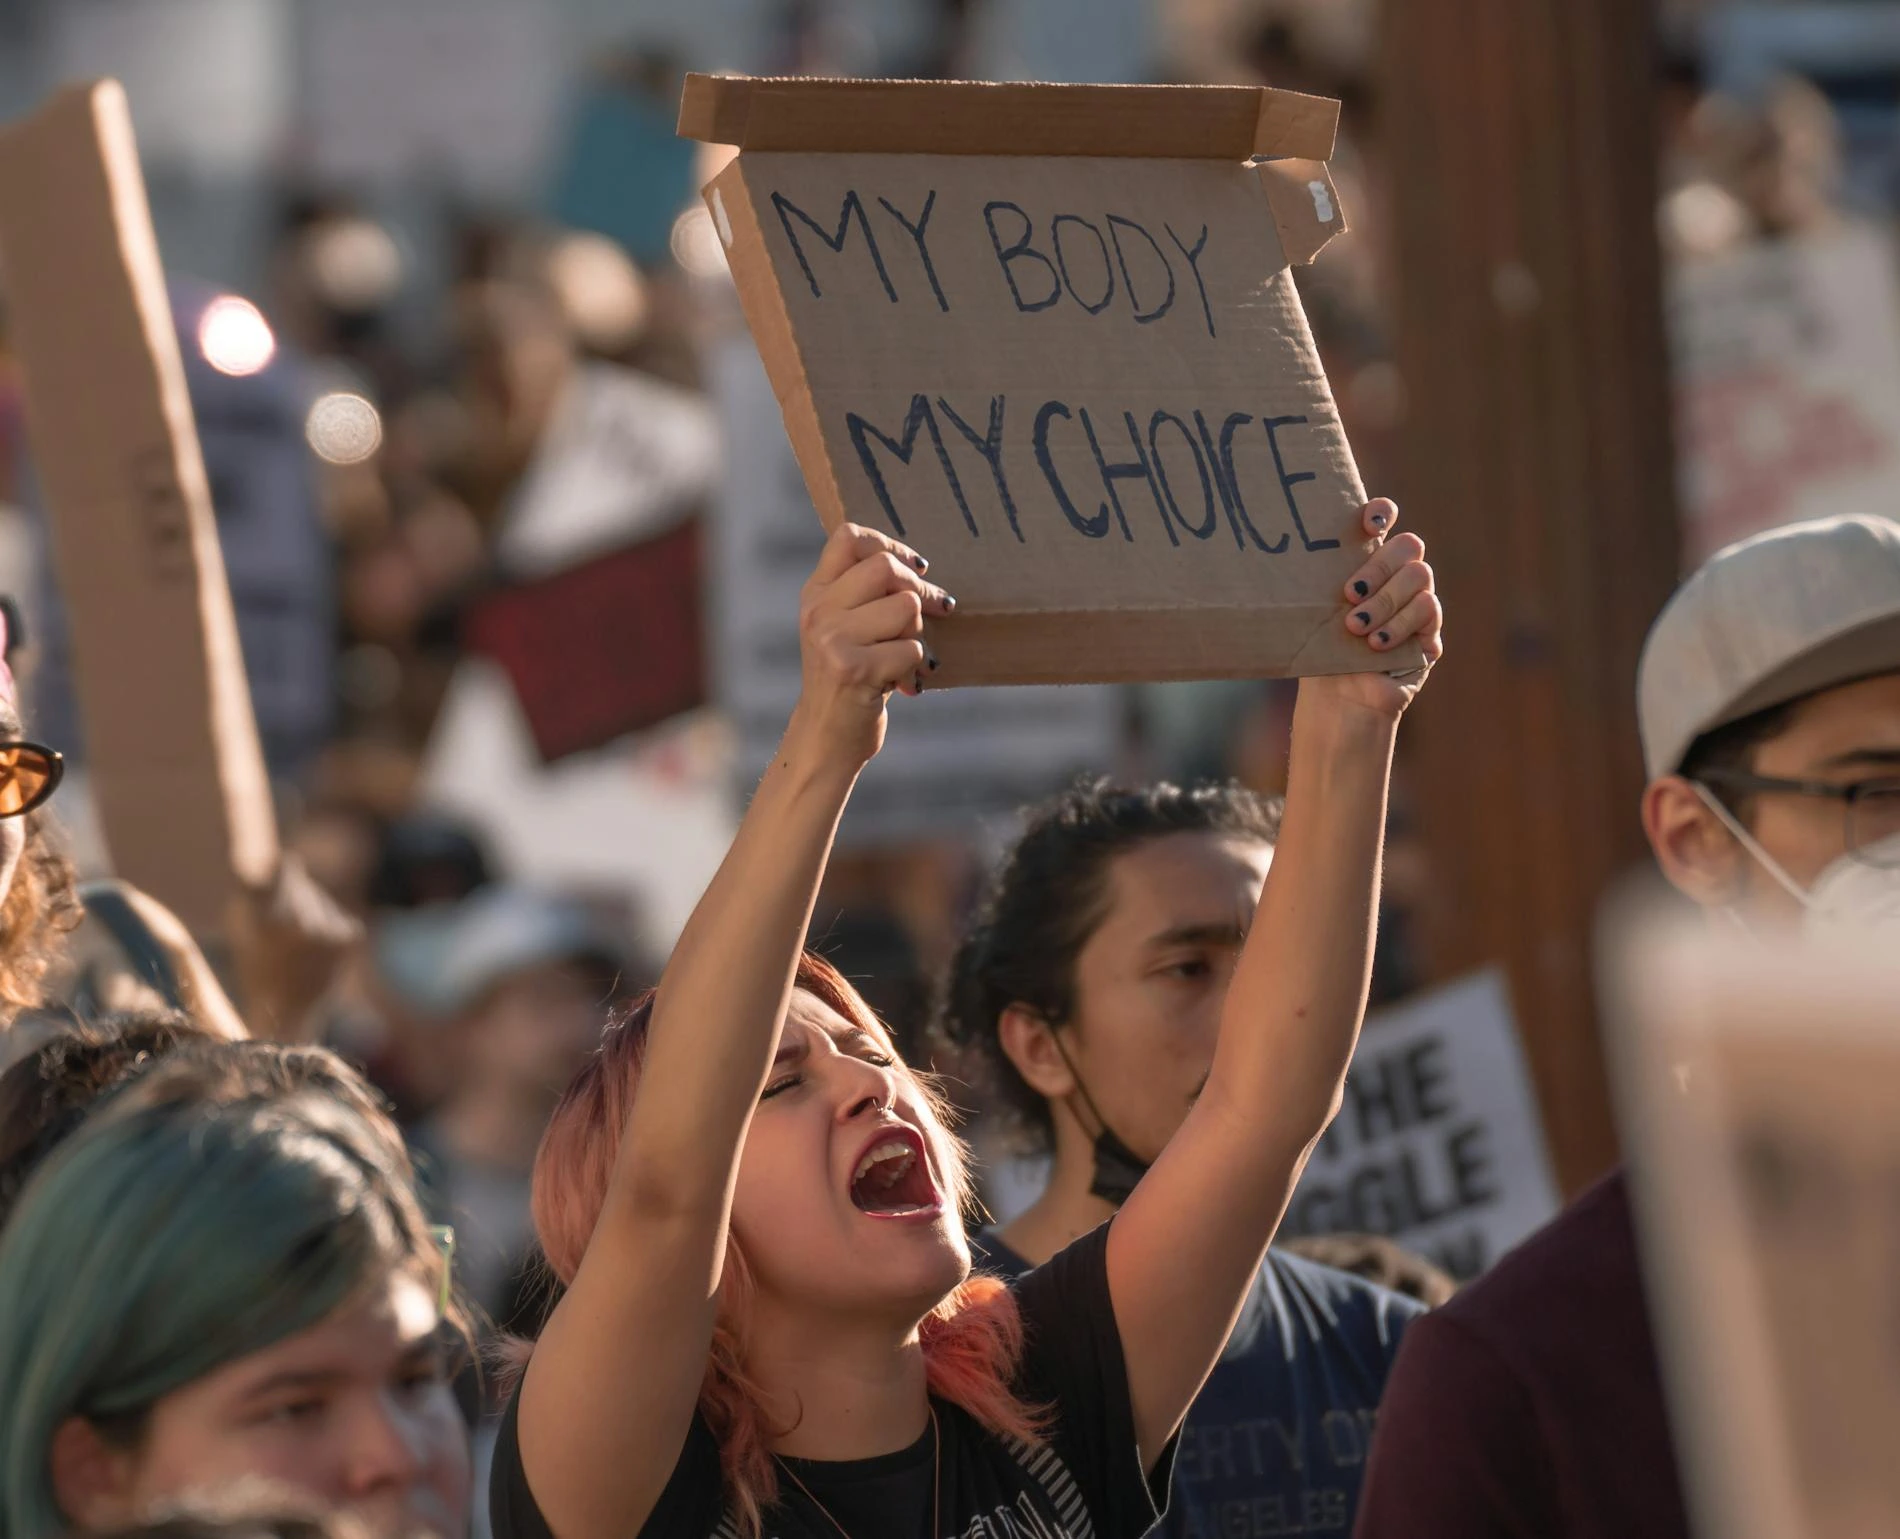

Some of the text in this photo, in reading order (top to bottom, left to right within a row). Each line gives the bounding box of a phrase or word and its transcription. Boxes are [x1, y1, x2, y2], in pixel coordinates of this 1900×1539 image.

[770, 189, 1216, 339] MY BODY
[846, 393, 1341, 555] MY CHOICE
